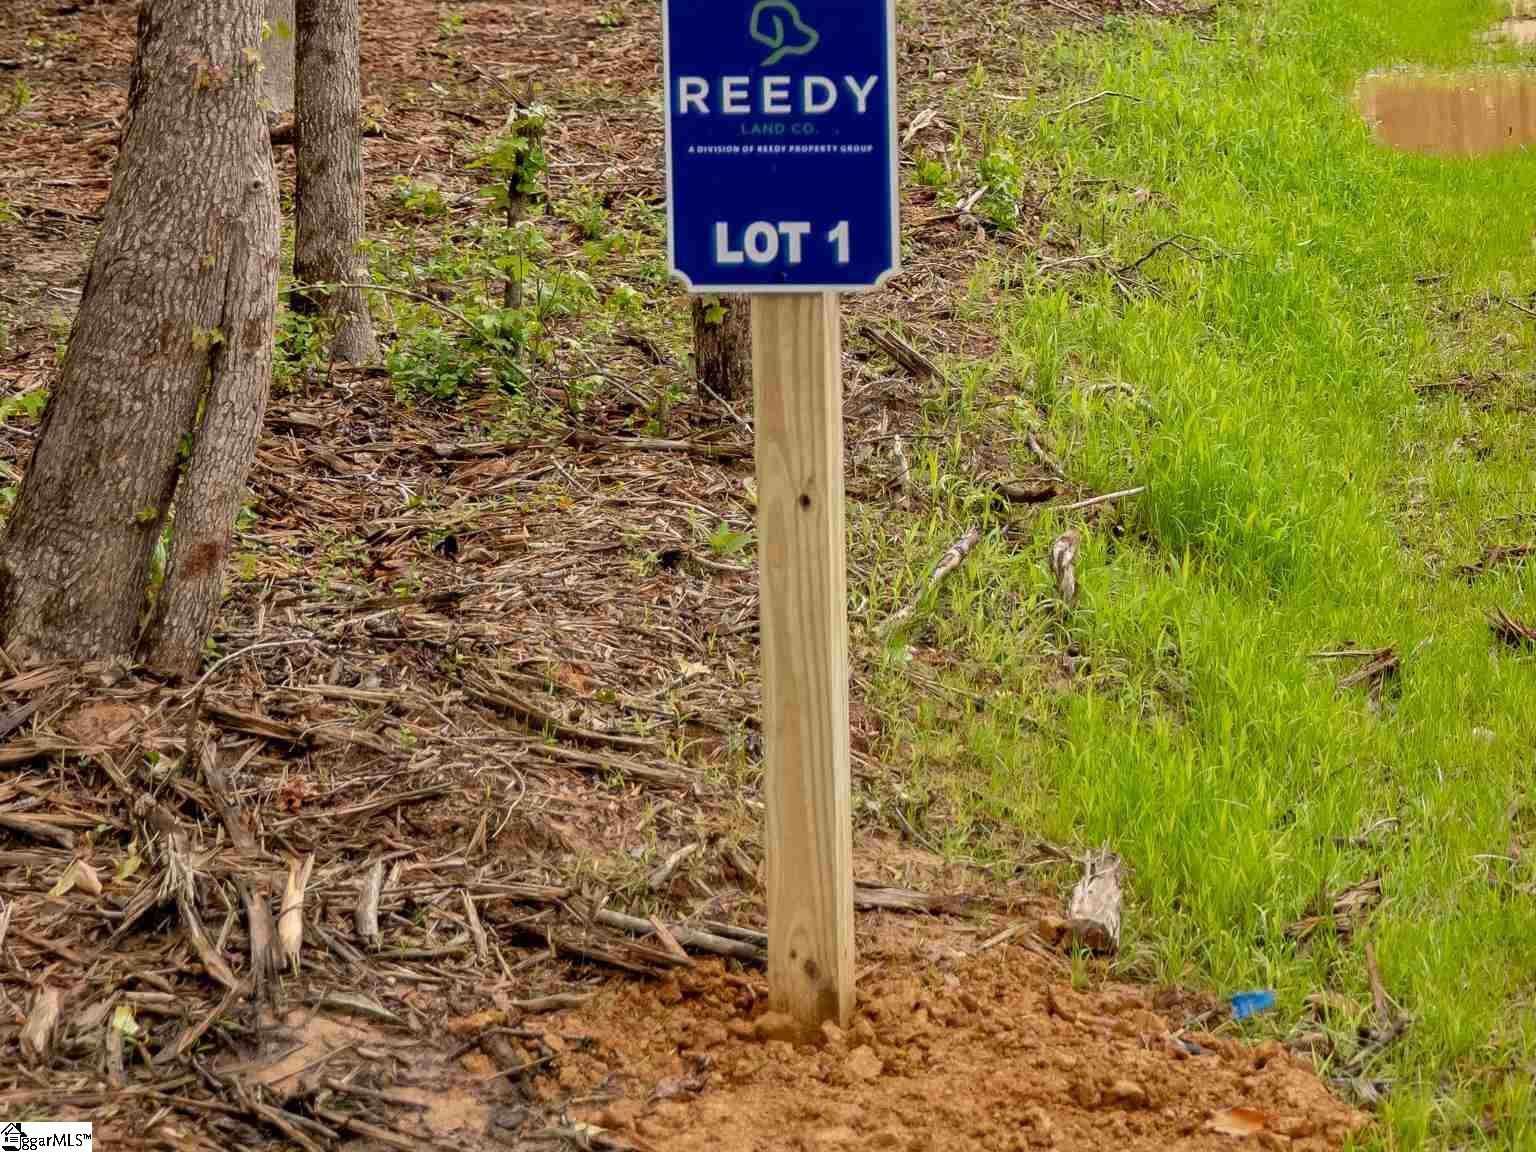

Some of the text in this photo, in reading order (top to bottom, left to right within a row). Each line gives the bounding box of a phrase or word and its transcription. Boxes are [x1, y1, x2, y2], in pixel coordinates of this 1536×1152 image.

[678, 75, 878, 115] REEDY
[741, 122, 785, 136] LAND
[688, 144, 873, 153] A DIVISION OF REEDY PROPERTY GROUP
[714, 220, 850, 265] LOT 1
